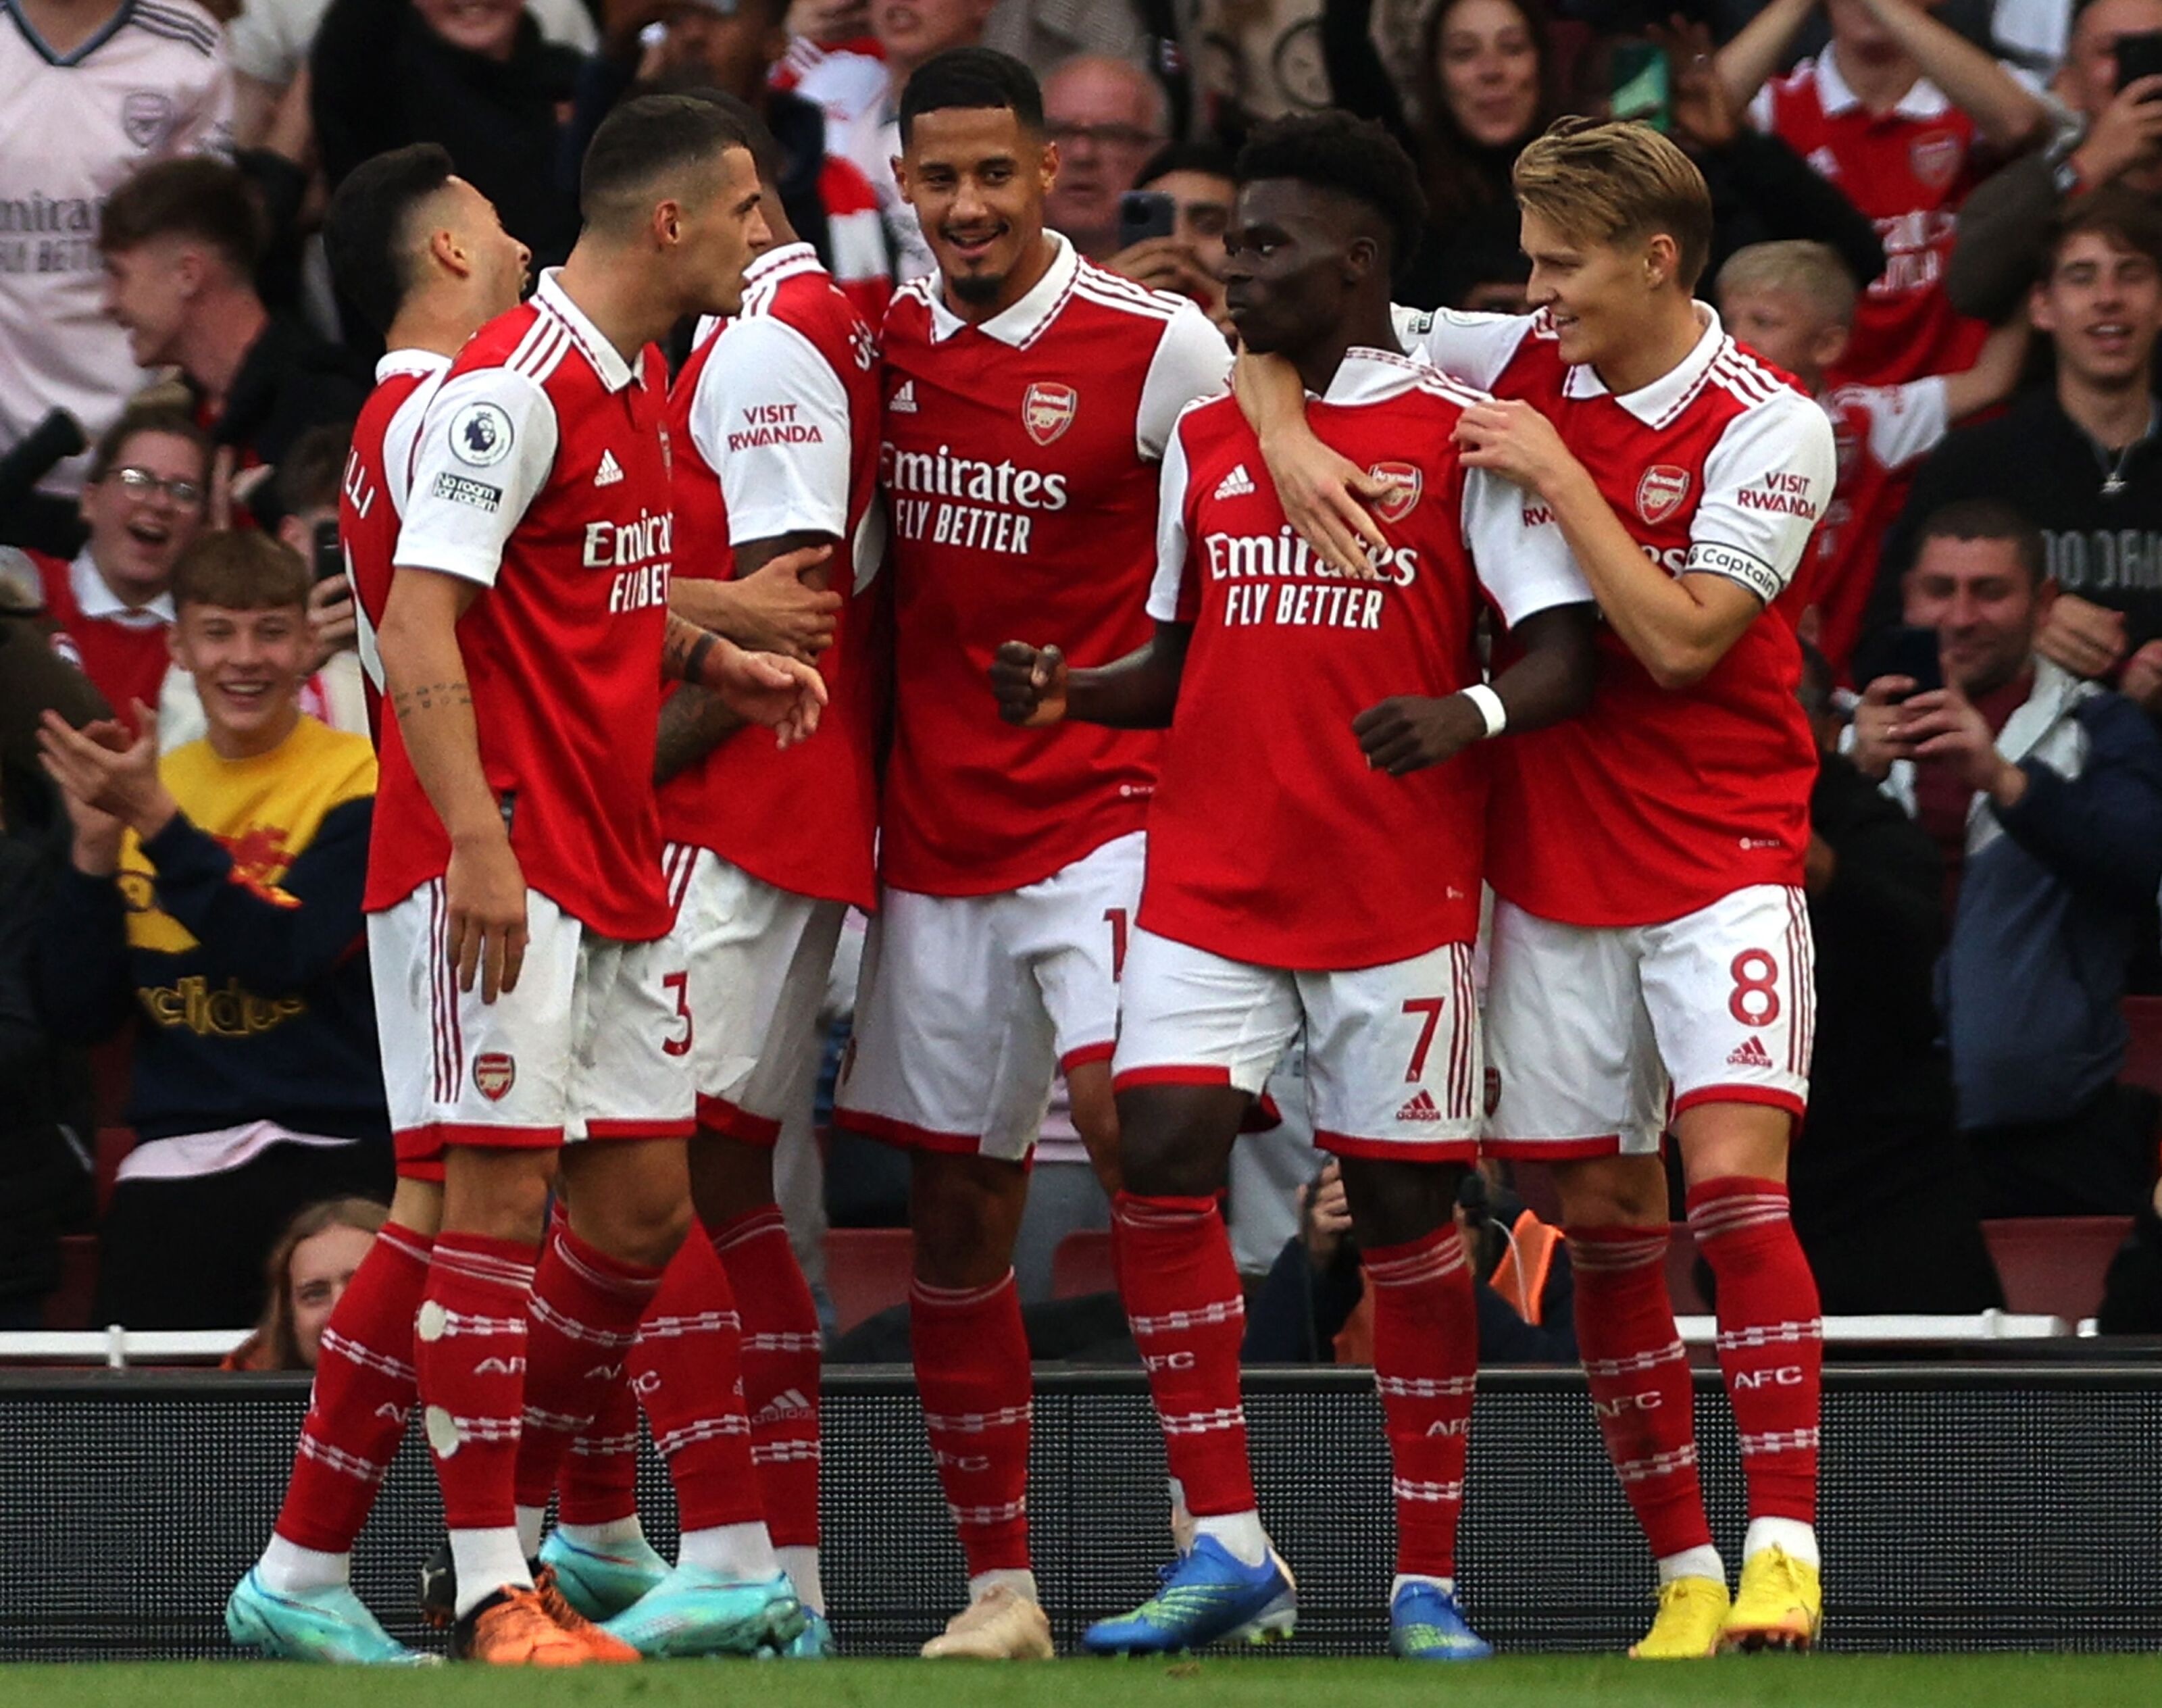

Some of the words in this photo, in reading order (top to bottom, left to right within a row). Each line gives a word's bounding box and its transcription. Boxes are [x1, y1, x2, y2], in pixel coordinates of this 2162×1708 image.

[743, 404, 797, 425] VISIT
[728, 425, 823, 453] RWANDA
[438, 472, 457, 488] No
[457, 479, 495, 501] room
[1765, 472, 1810, 495] VISIT
[454, 491, 499, 514] racism
[1737, 488, 1817, 520] RWANDA
[896, 498, 930, 540] FLY
[933, 503, 1031, 555] BETTER
[1703, 548, 1776, 596] Captain
[1224, 584, 1270, 627] FLY
[1275, 584, 1383, 630] BETTER
[1103, 908, 1127, 984] 1
[1728, 948, 1780, 1027] 8
[661, 970, 693, 1057] 3
[1401, 997, 1445, 1082] 7
[1726, 1054, 1774, 1070] adidas
[1396, 1109, 1441, 1122] adidas
[1734, 1366, 1803, 1390] AFC
[1593, 1391, 1663, 1417] AFC
